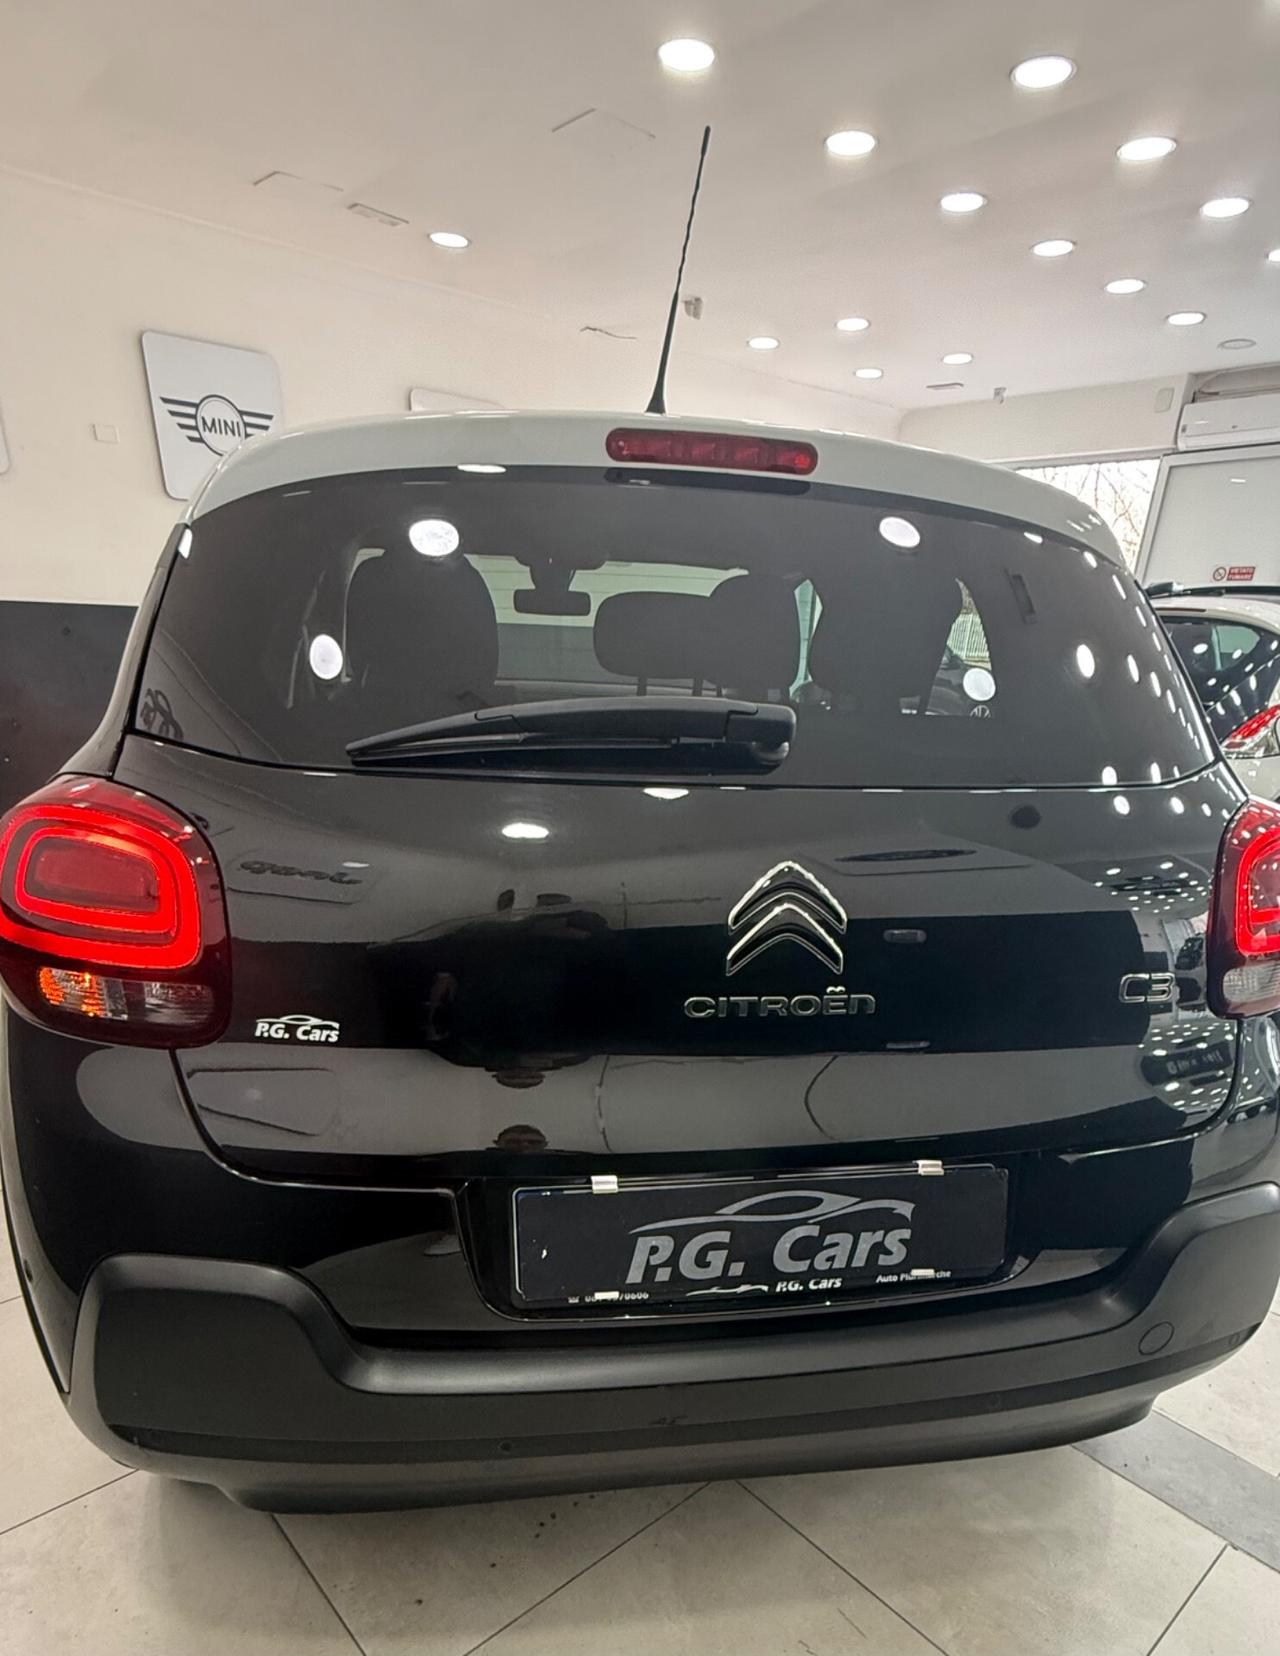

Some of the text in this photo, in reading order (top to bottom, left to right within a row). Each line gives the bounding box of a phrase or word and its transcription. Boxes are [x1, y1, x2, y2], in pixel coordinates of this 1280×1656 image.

[201, 415, 241, 438] MINI
[1119, 972, 1176, 1004] C3
[254, 1022, 340, 1043] P.G. Cars
[625, 1224, 912, 1284] P.G. Cars
[775, 1277, 843, 1293] P.G. Cars
[875, 1274, 898, 1284] Auto
